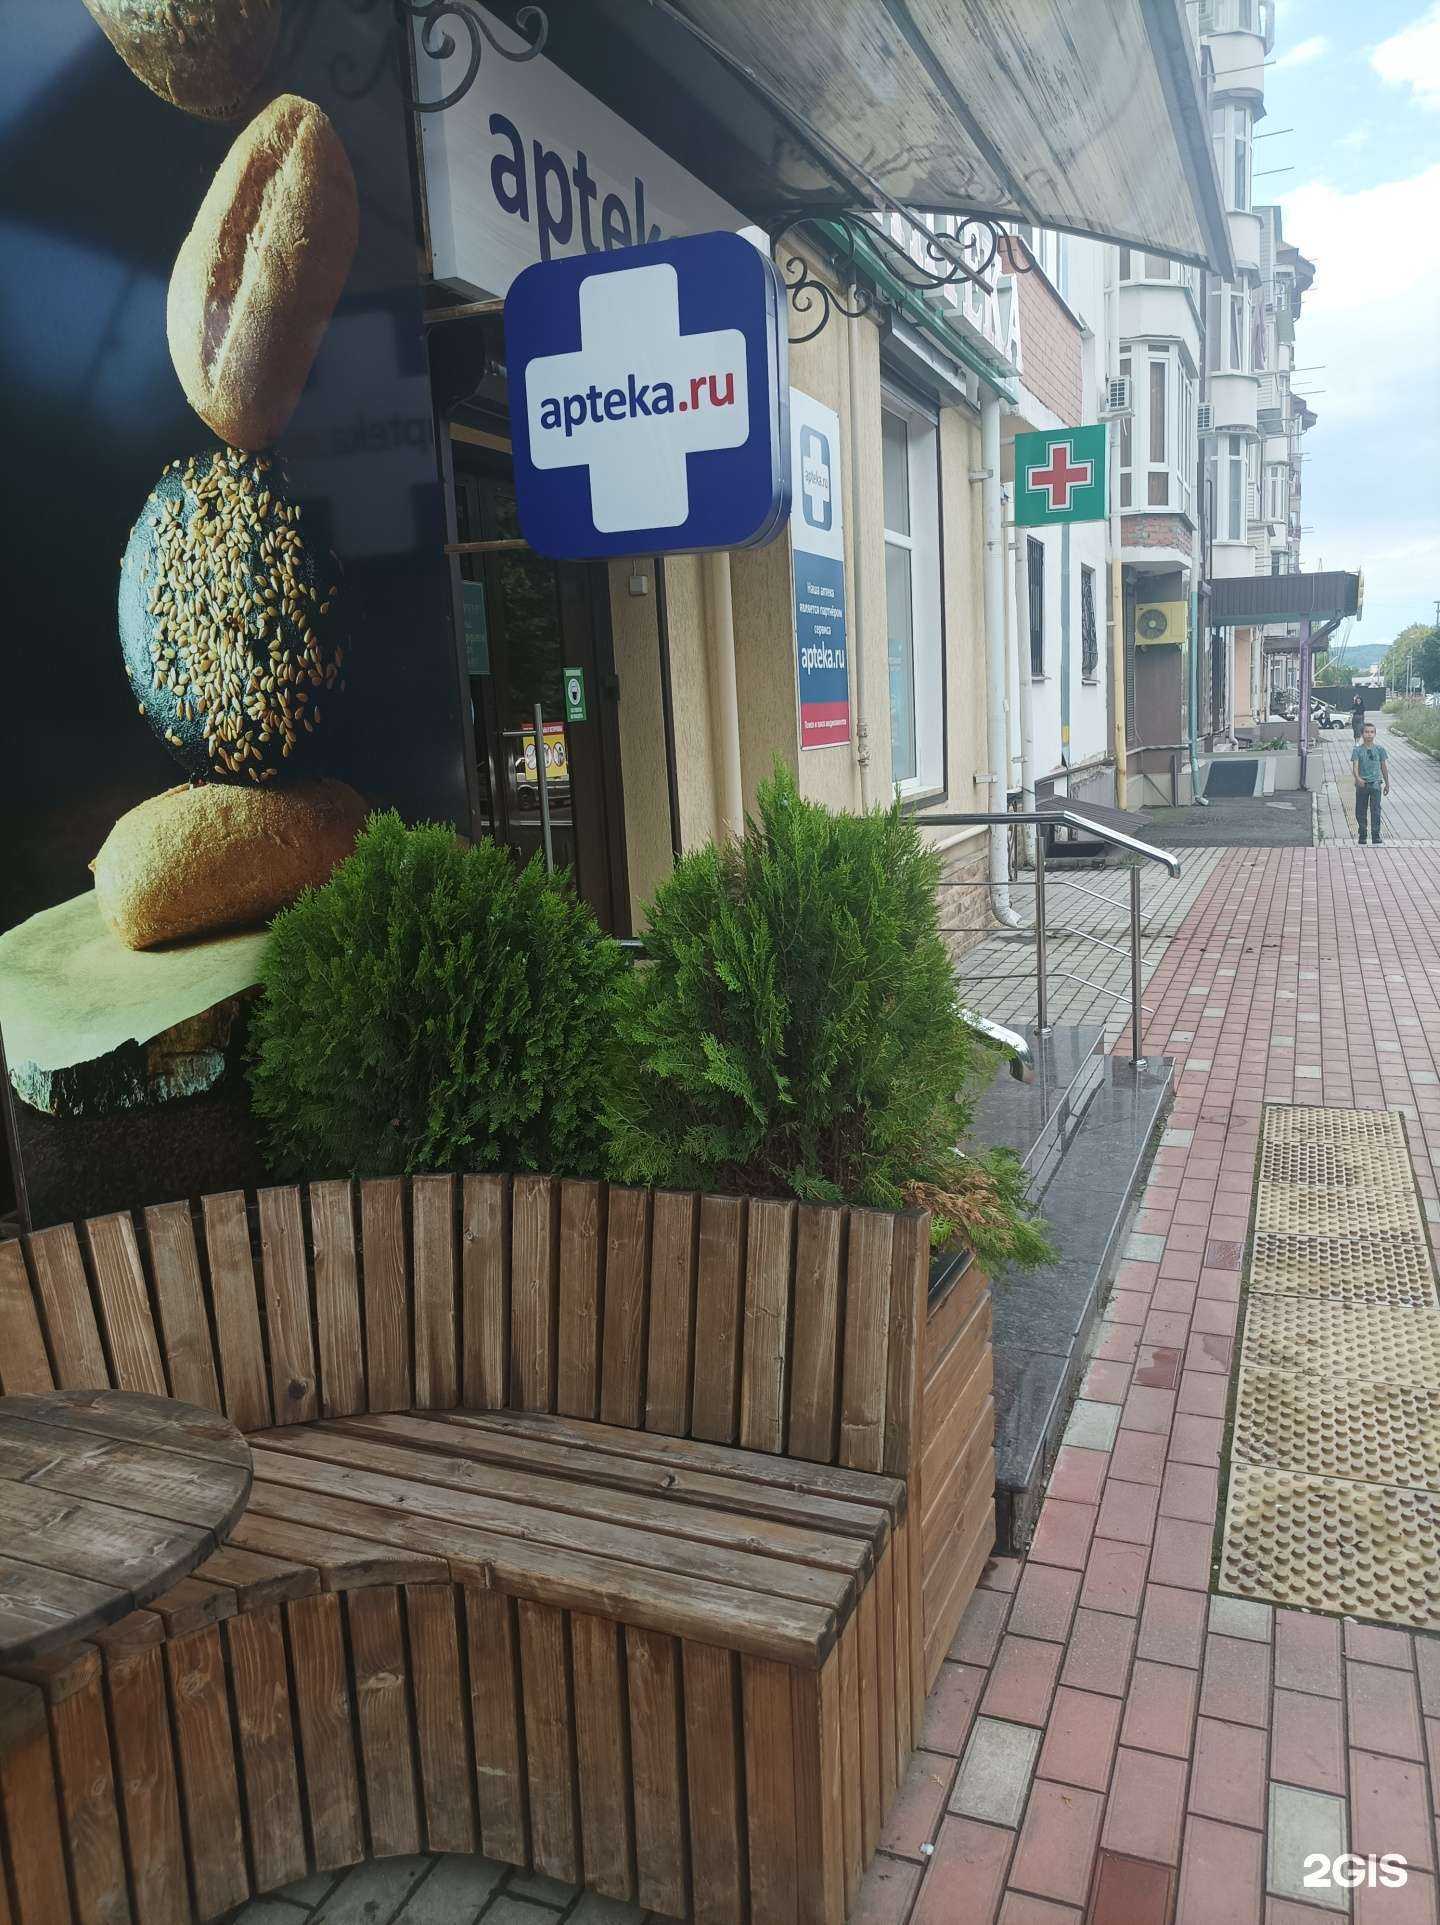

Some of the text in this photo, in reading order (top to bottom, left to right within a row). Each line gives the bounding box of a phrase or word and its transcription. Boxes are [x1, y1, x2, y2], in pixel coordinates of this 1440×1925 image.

[489, 112, 684, 262] aptek
[540, 372, 735, 437] apteka.ru
[801, 641, 845, 675] apteka.ru
